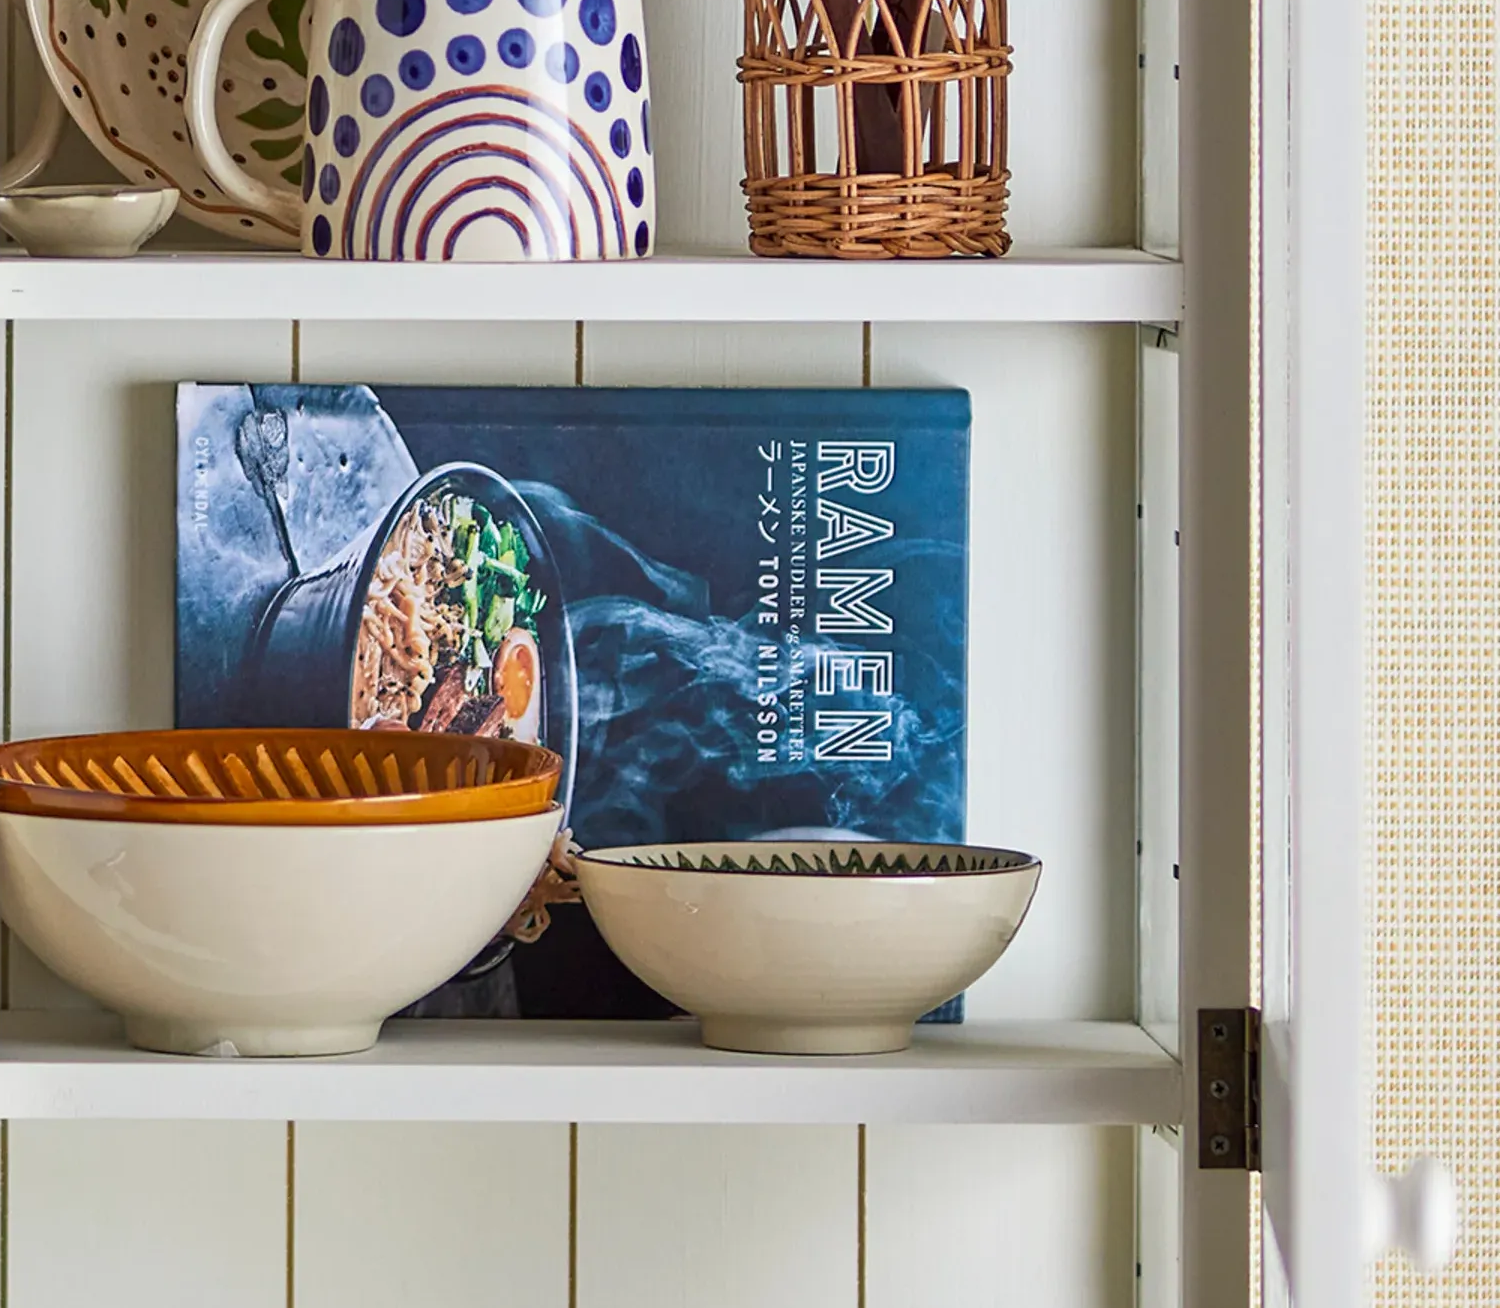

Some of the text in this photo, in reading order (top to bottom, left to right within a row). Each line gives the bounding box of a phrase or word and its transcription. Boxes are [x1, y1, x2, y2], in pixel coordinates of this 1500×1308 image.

[758, 440, 782, 544] ラーメン
[786, 440, 808, 763] JAPANSKE NUDLER og SMÅRETTER
[815, 441, 895, 761] RAMEN
[757, 556, 779, 763] TOVE NILSSON
